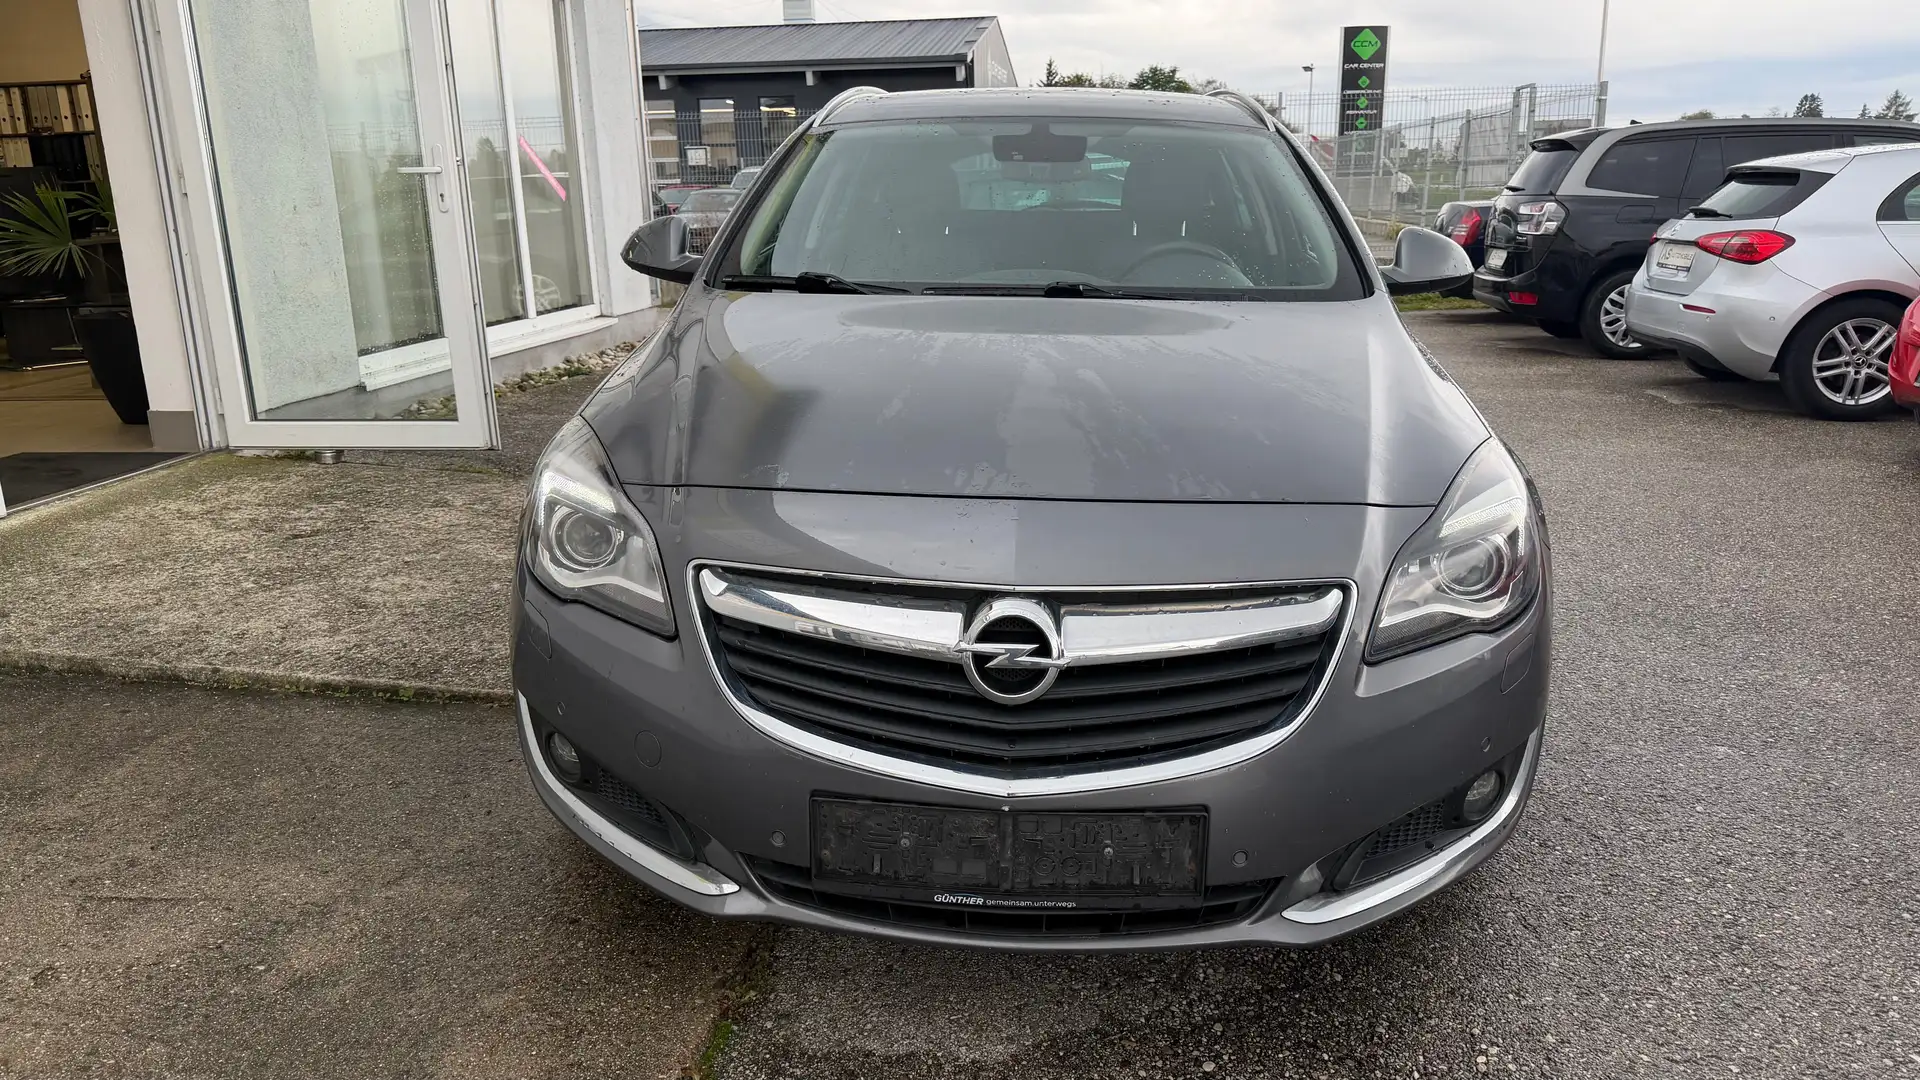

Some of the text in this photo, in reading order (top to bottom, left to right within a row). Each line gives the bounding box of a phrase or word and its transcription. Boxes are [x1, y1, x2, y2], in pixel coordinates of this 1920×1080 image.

[1353, 40, 1378, 48] CCM
[934, 893, 1077, 908] GÜNTHER gemeinsam.unterwegs
